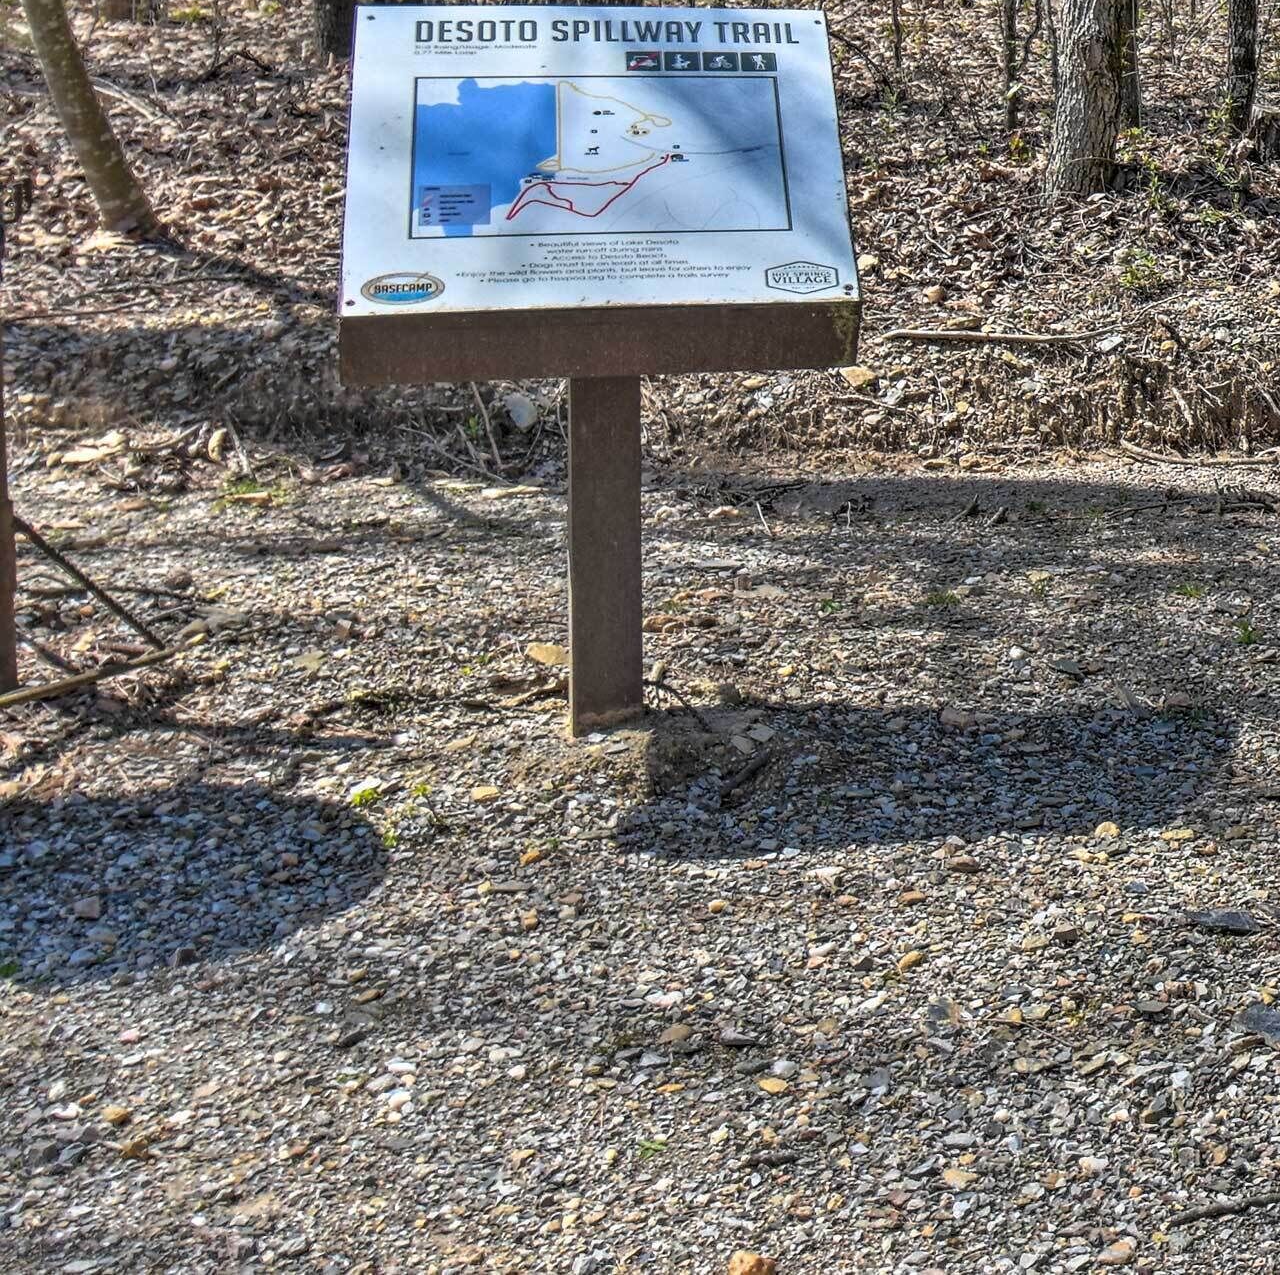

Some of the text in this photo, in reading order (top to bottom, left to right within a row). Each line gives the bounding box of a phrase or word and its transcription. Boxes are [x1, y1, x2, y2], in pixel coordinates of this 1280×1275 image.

[415, 20, 800, 44] DESOTO SPILLWAY TRAIL
[772, 276, 832, 284] VILLAGE
[373, 282, 433, 294] BASECAMP
